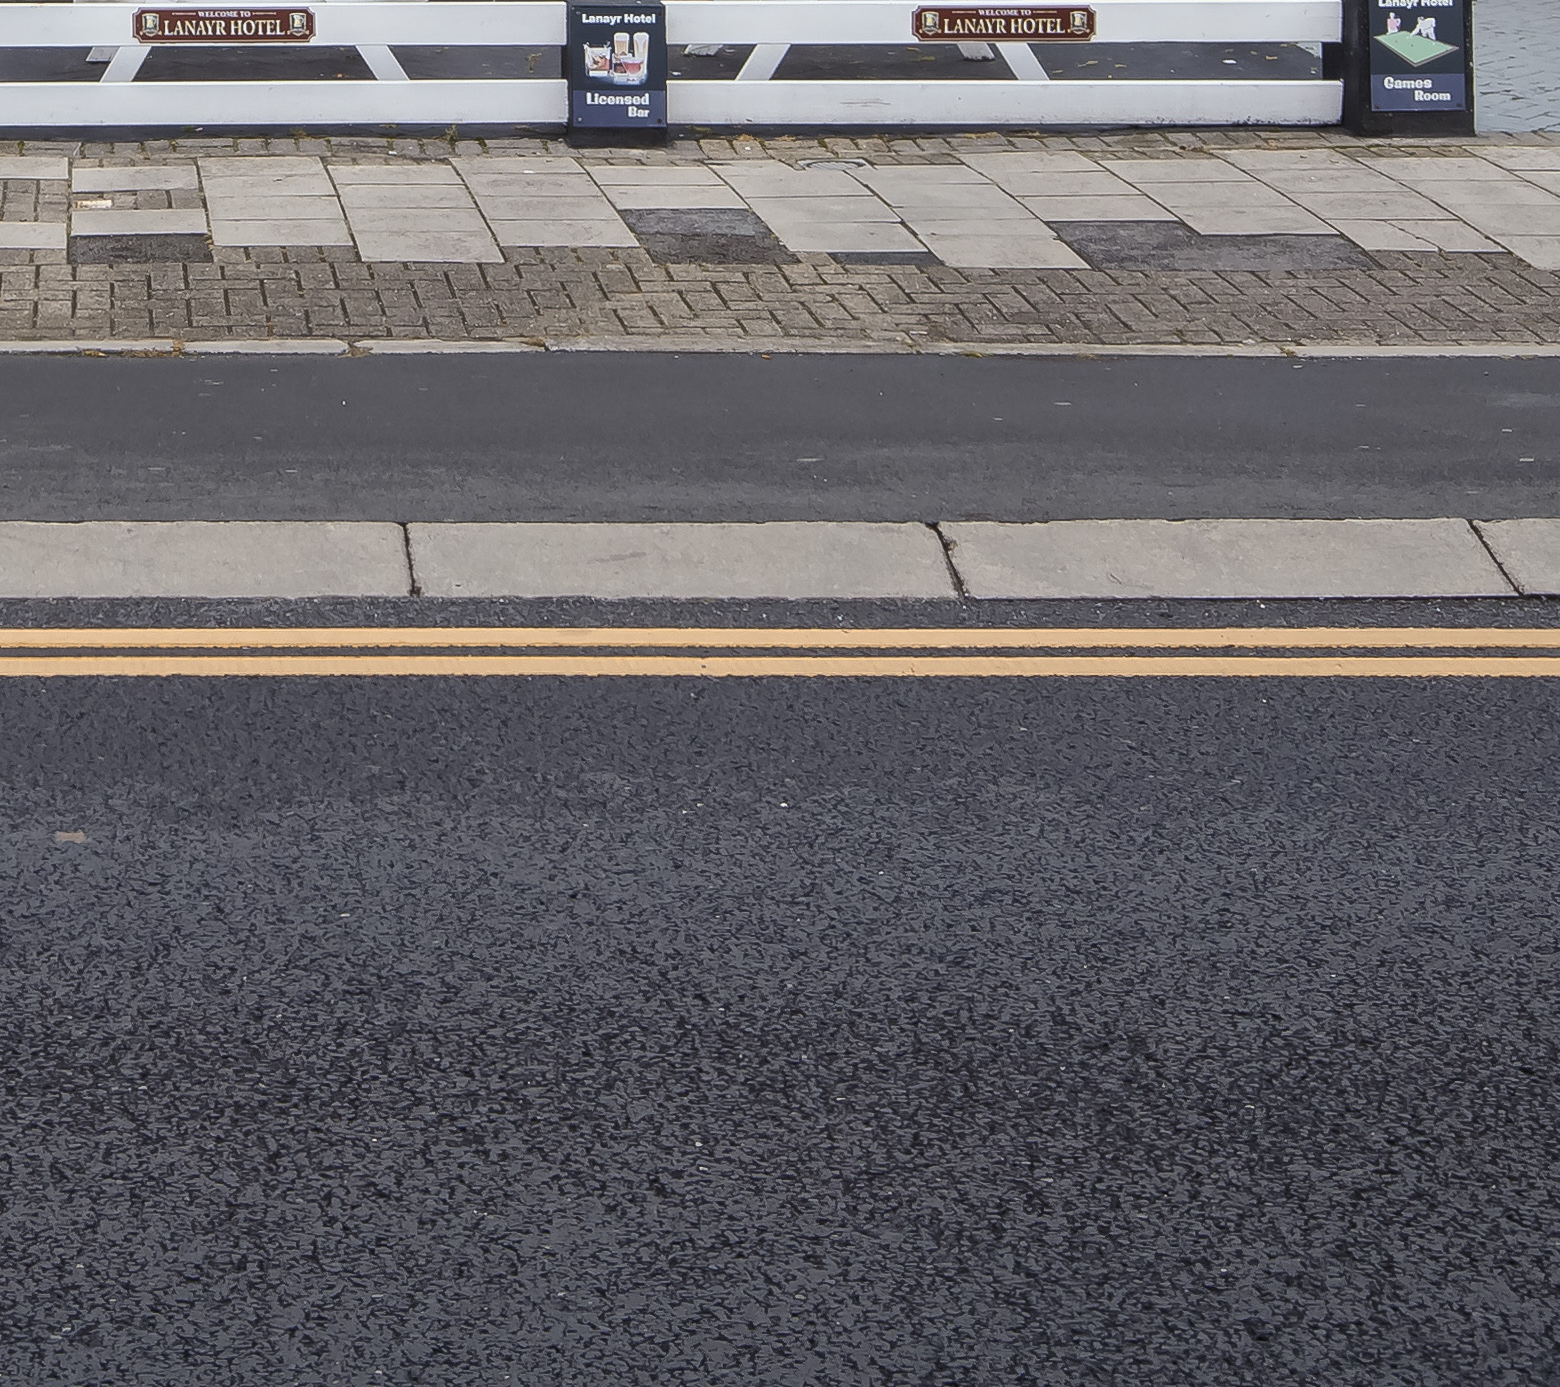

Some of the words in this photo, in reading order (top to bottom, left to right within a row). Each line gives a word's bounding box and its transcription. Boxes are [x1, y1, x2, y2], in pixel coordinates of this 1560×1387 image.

[582, 13, 622, 25] Lanayr
[623, 13, 656, 23] Hotel
[164, 20, 226, 36] LANAYR
[230, 20, 285, 36] HOTEL
[944, 18, 1006, 34] LANAYR
[1010, 18, 1065, 34] HOTEL
[1383, 76, 1432, 89] Games
[586, 92, 650, 105] Licensed
[1414, 90, 1451, 101] Room
[627, 106, 650, 118] Bar
